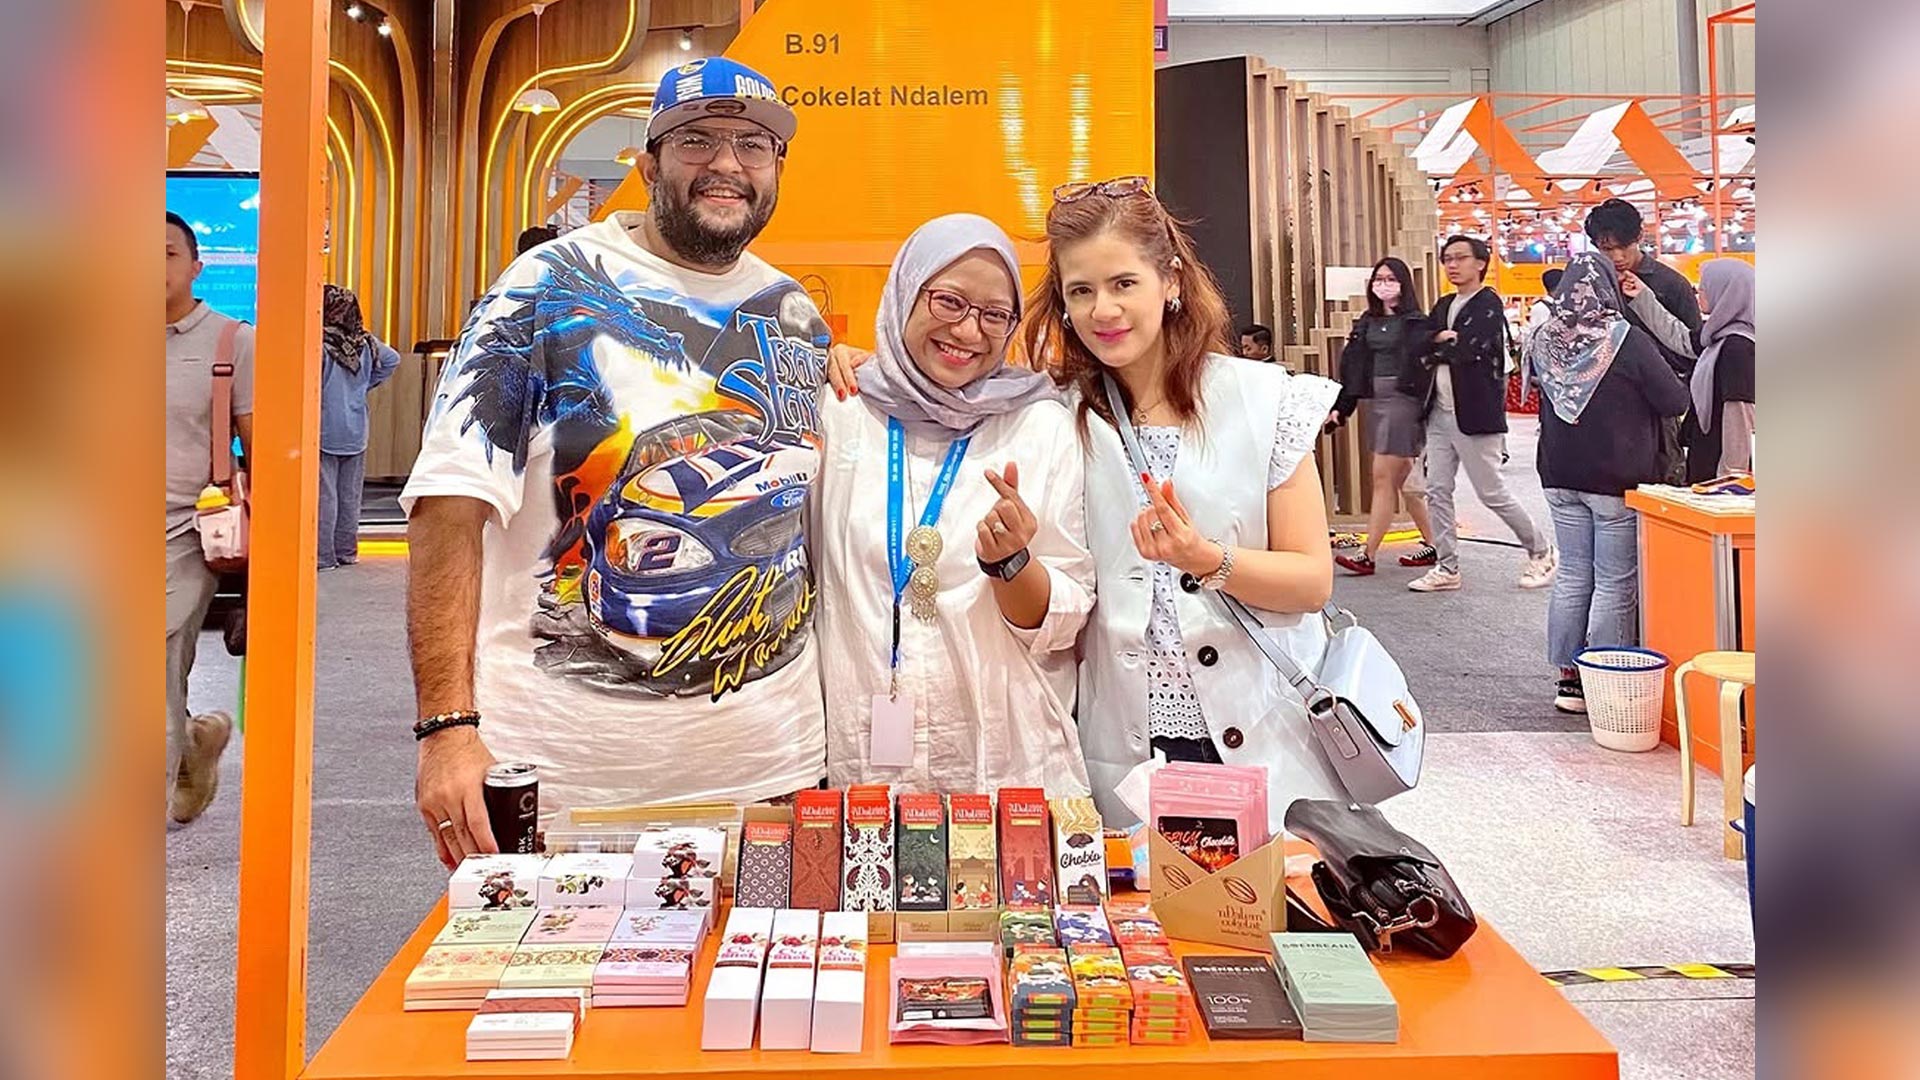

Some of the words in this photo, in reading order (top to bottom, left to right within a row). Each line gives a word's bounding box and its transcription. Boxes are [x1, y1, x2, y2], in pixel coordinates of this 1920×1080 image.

[785, 33, 840, 54] B.91
[781, 86, 882, 106] Cokelat
[890, 85, 989, 106] Ndalem
[755, 474, 798, 493] Mobil
[633, 531, 682, 571] 2
[1200, 835, 1237, 848] Chocolate
